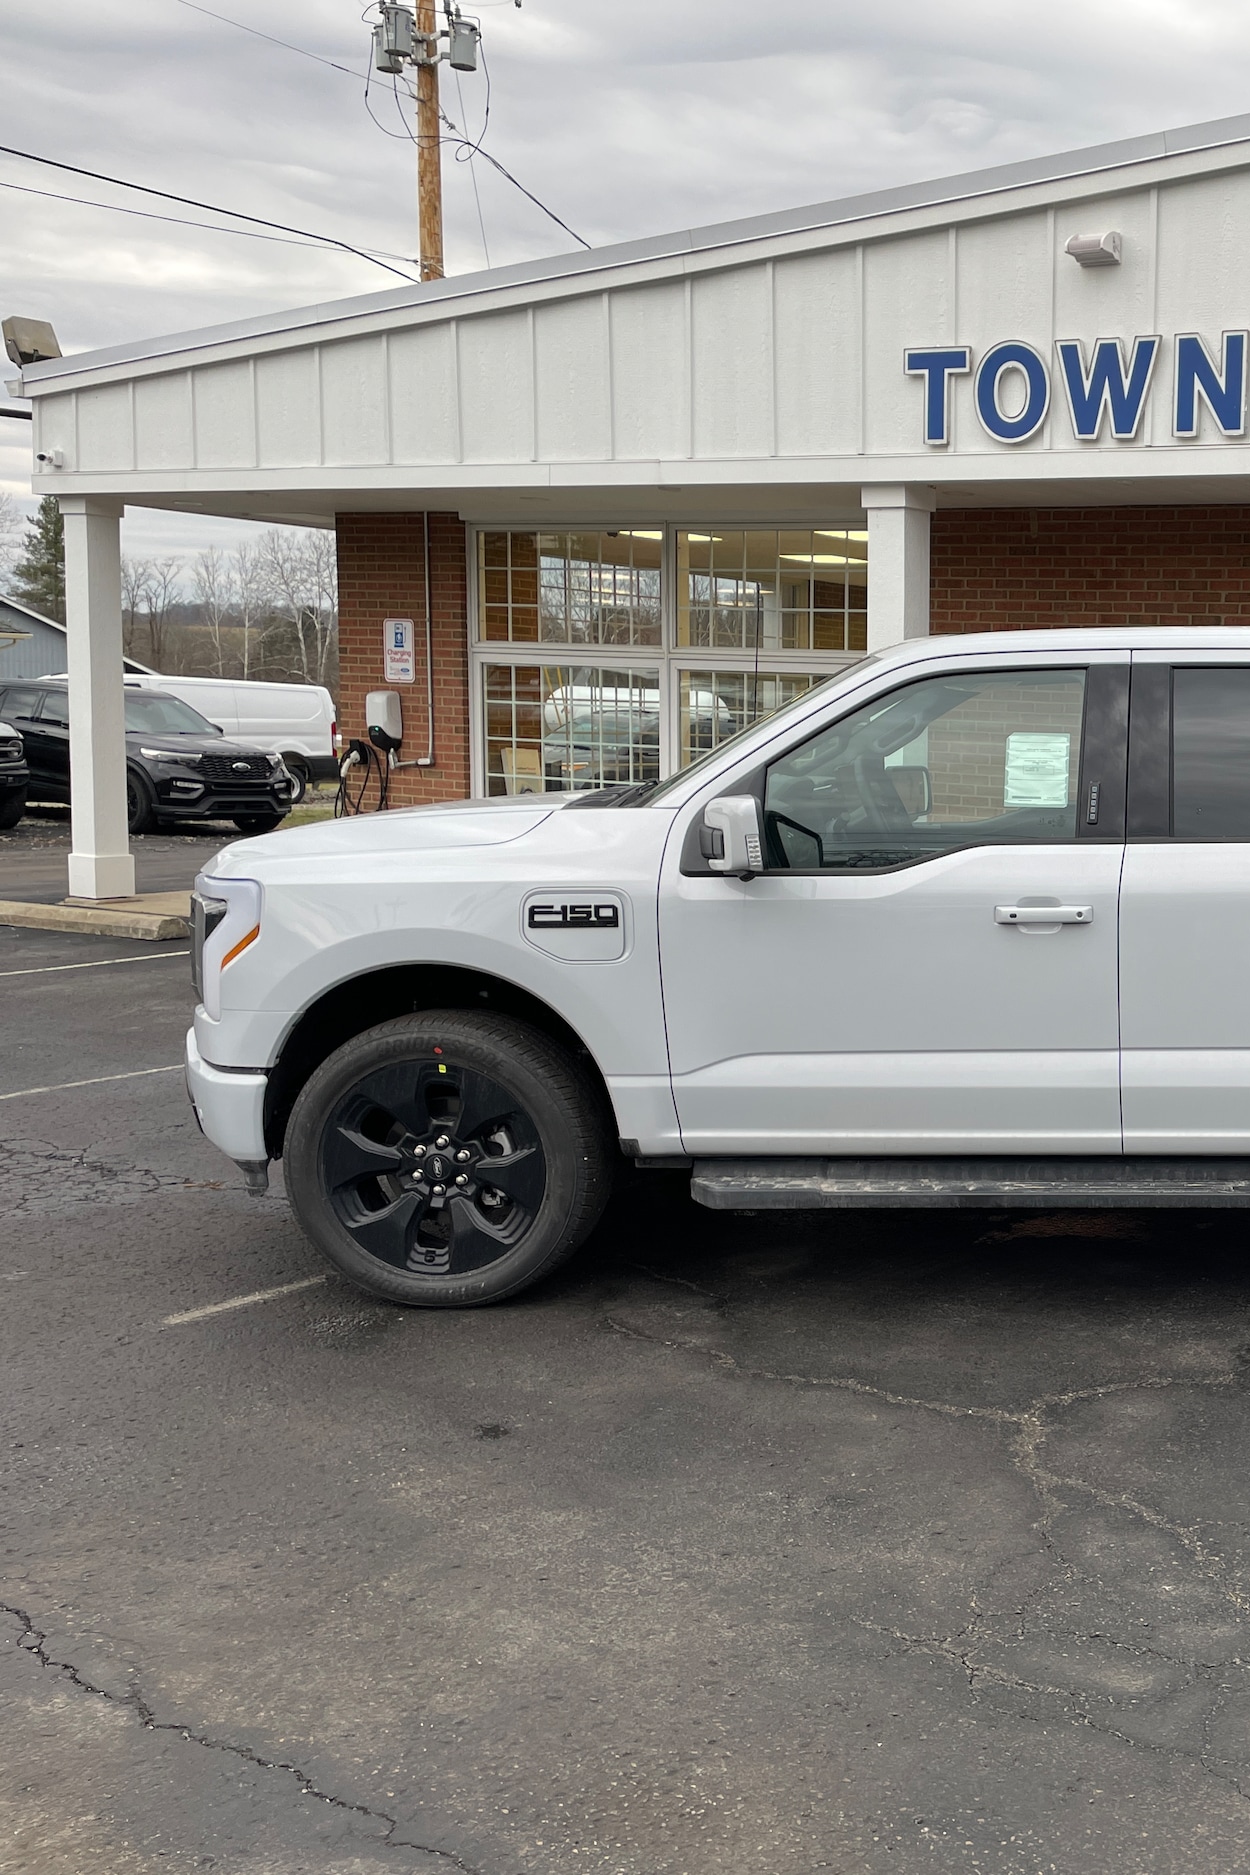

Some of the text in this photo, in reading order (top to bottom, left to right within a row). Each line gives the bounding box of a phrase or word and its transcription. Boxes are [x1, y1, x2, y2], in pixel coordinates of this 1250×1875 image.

[903, 329, 1250, 447] TOWN
[387, 648, 412, 657] Charging
[389, 656, 410, 664] Station
